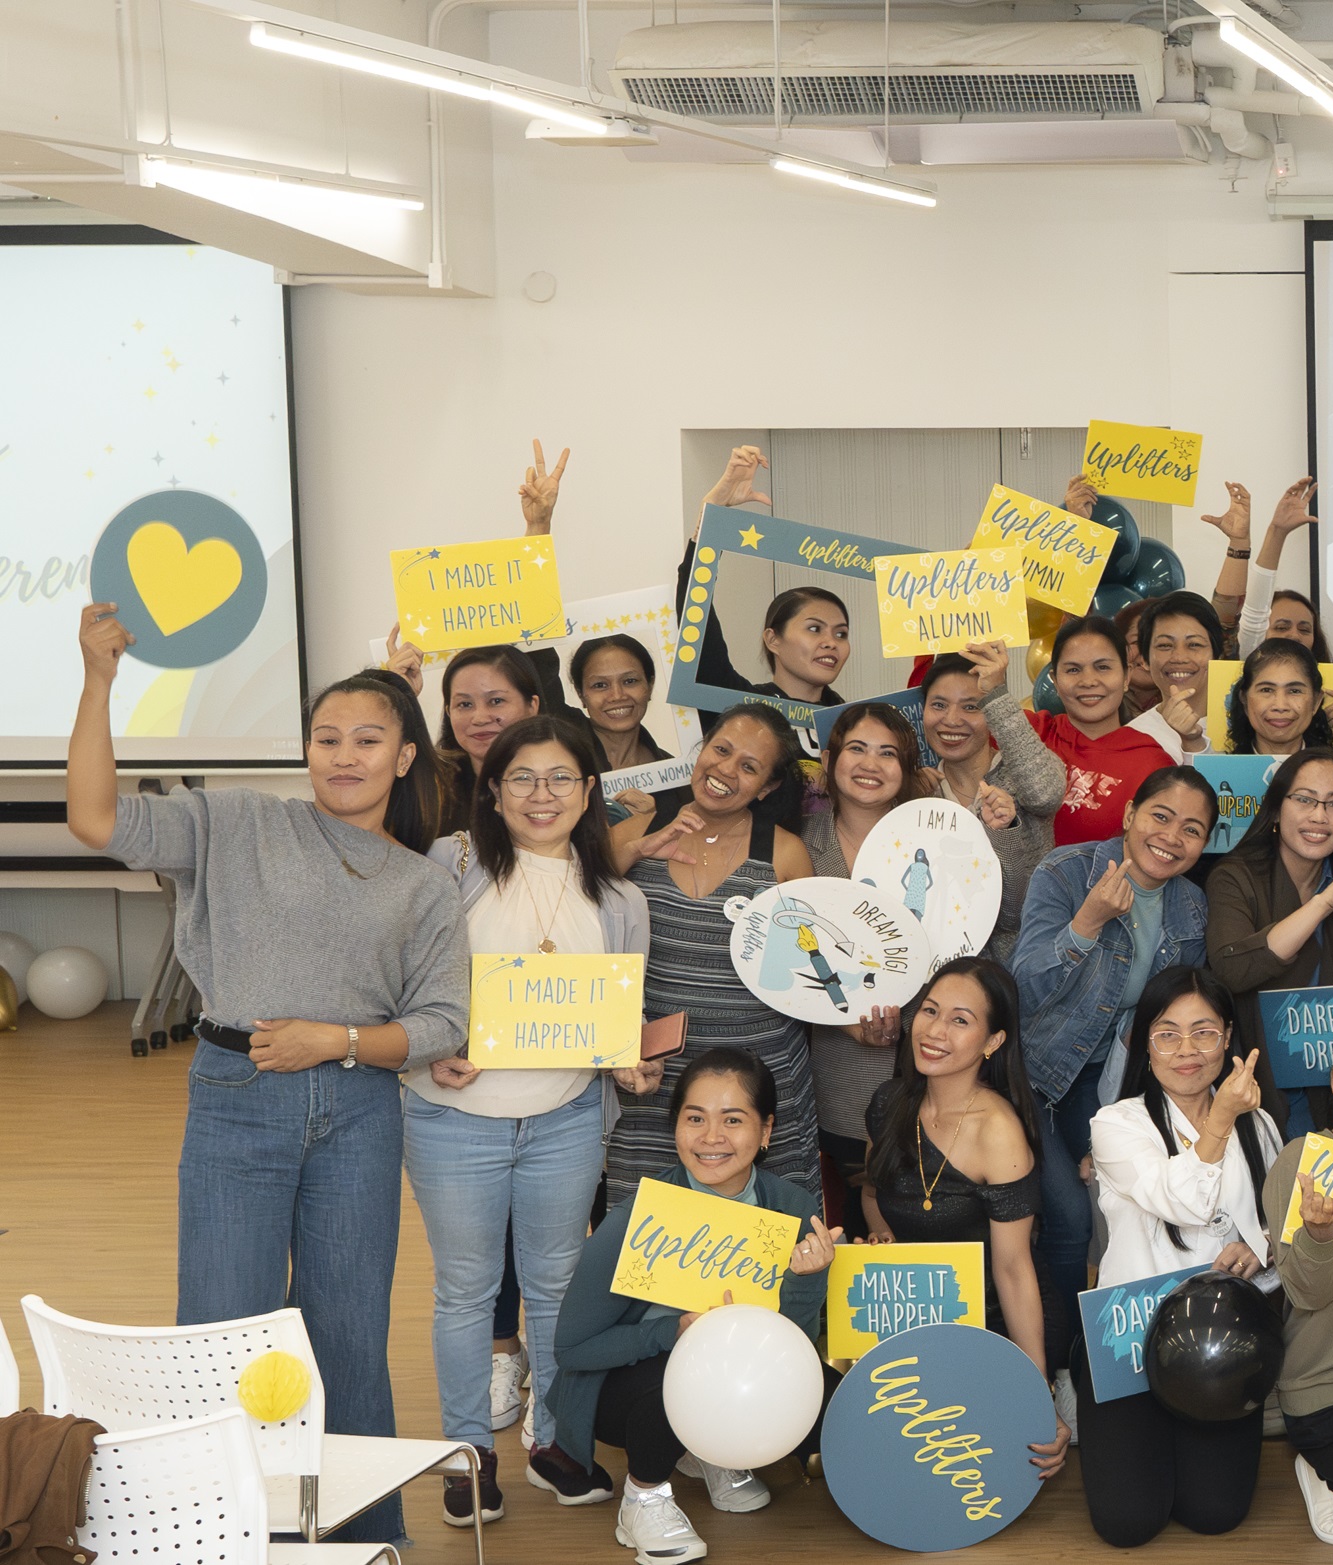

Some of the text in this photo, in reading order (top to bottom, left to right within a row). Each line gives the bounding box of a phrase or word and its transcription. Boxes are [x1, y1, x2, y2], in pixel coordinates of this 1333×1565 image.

[1087, 440, 1198, 483] Uplifters
[991, 497, 1103, 565] Uplifters
[798, 535, 876, 573] Uplifters
[428, 560, 522, 591] I MADE IT
[887, 556, 1019, 607] Uplifters
[1022, 556, 1065, 593] UMNI
[442, 600, 522, 632] HAPPEN!
[918, 610, 993, 642] ALUMNI
[602, 770, 654, 796] BUSINESS
[917, 809, 957, 832] I AM A
[852, 900, 909, 974] DREAM BIG!
[508, 977, 606, 1005] I MADE IT
[514, 1020, 597, 1050] HAPPEN!
[628, 1214, 786, 1291] Uplifters
[861, 1271, 948, 1300] MAKE IT
[867, 1304, 944, 1333] HAPPEN
[868, 1356, 1003, 1521] Uplifters
